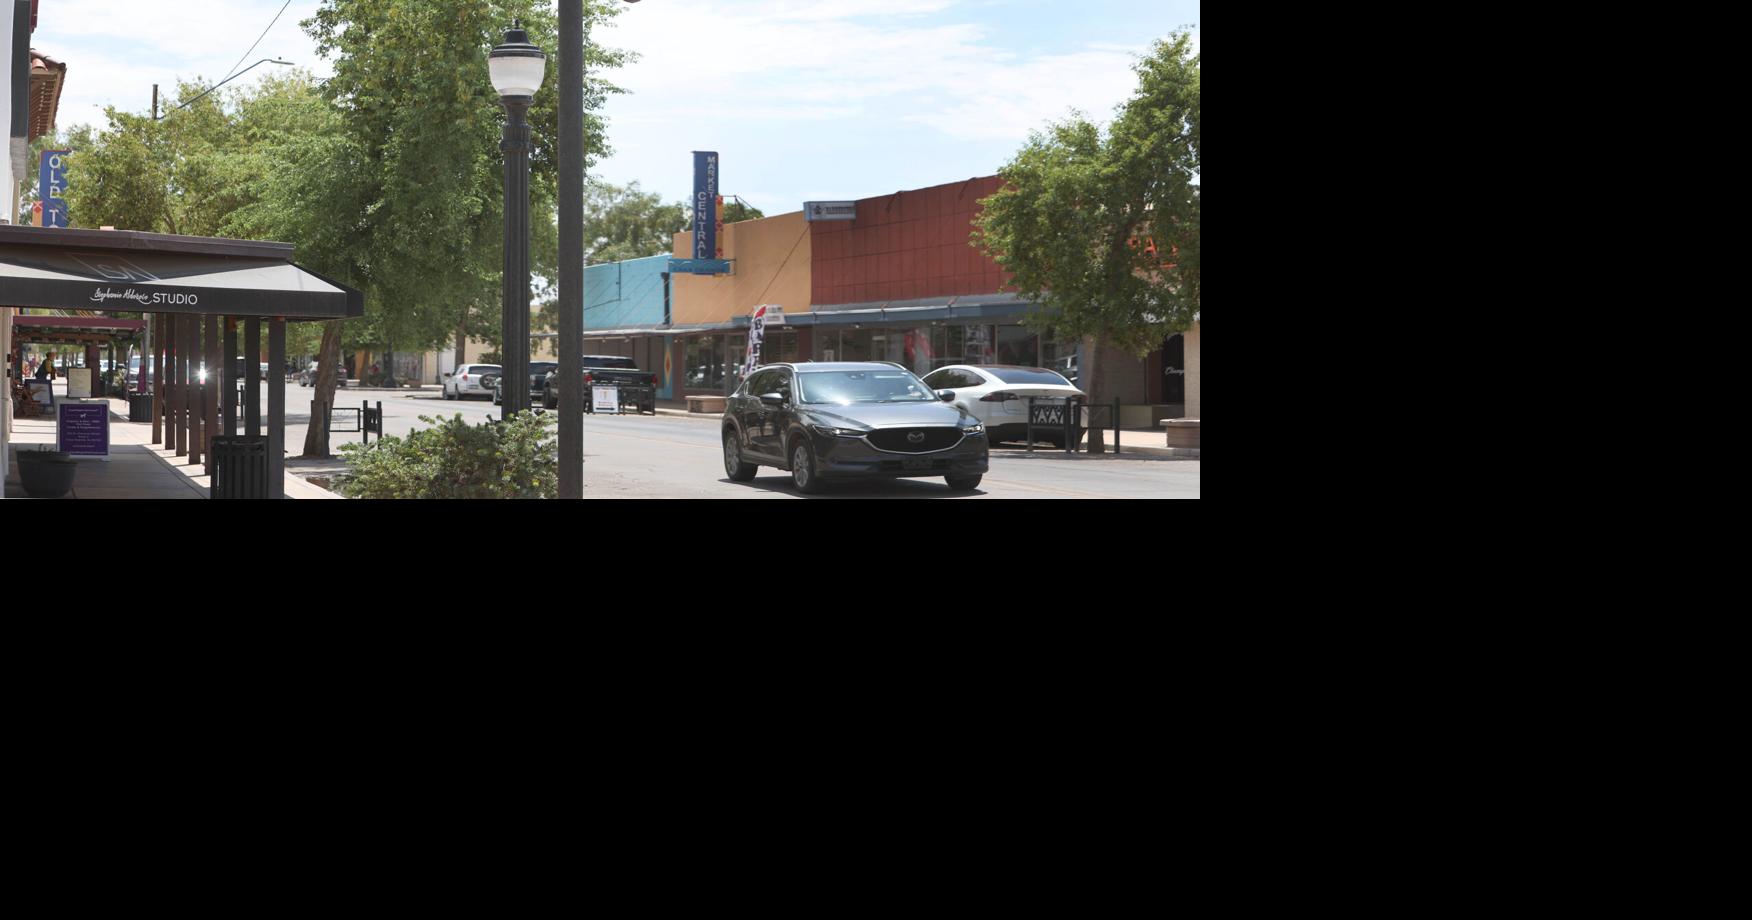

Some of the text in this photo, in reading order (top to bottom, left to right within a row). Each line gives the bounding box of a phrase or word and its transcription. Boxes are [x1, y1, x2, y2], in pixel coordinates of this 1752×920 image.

[707, 156, 715, 198] MARKET
[697, 192, 706, 259] CENTRAL
[152, 292, 198, 305] STUDIO
